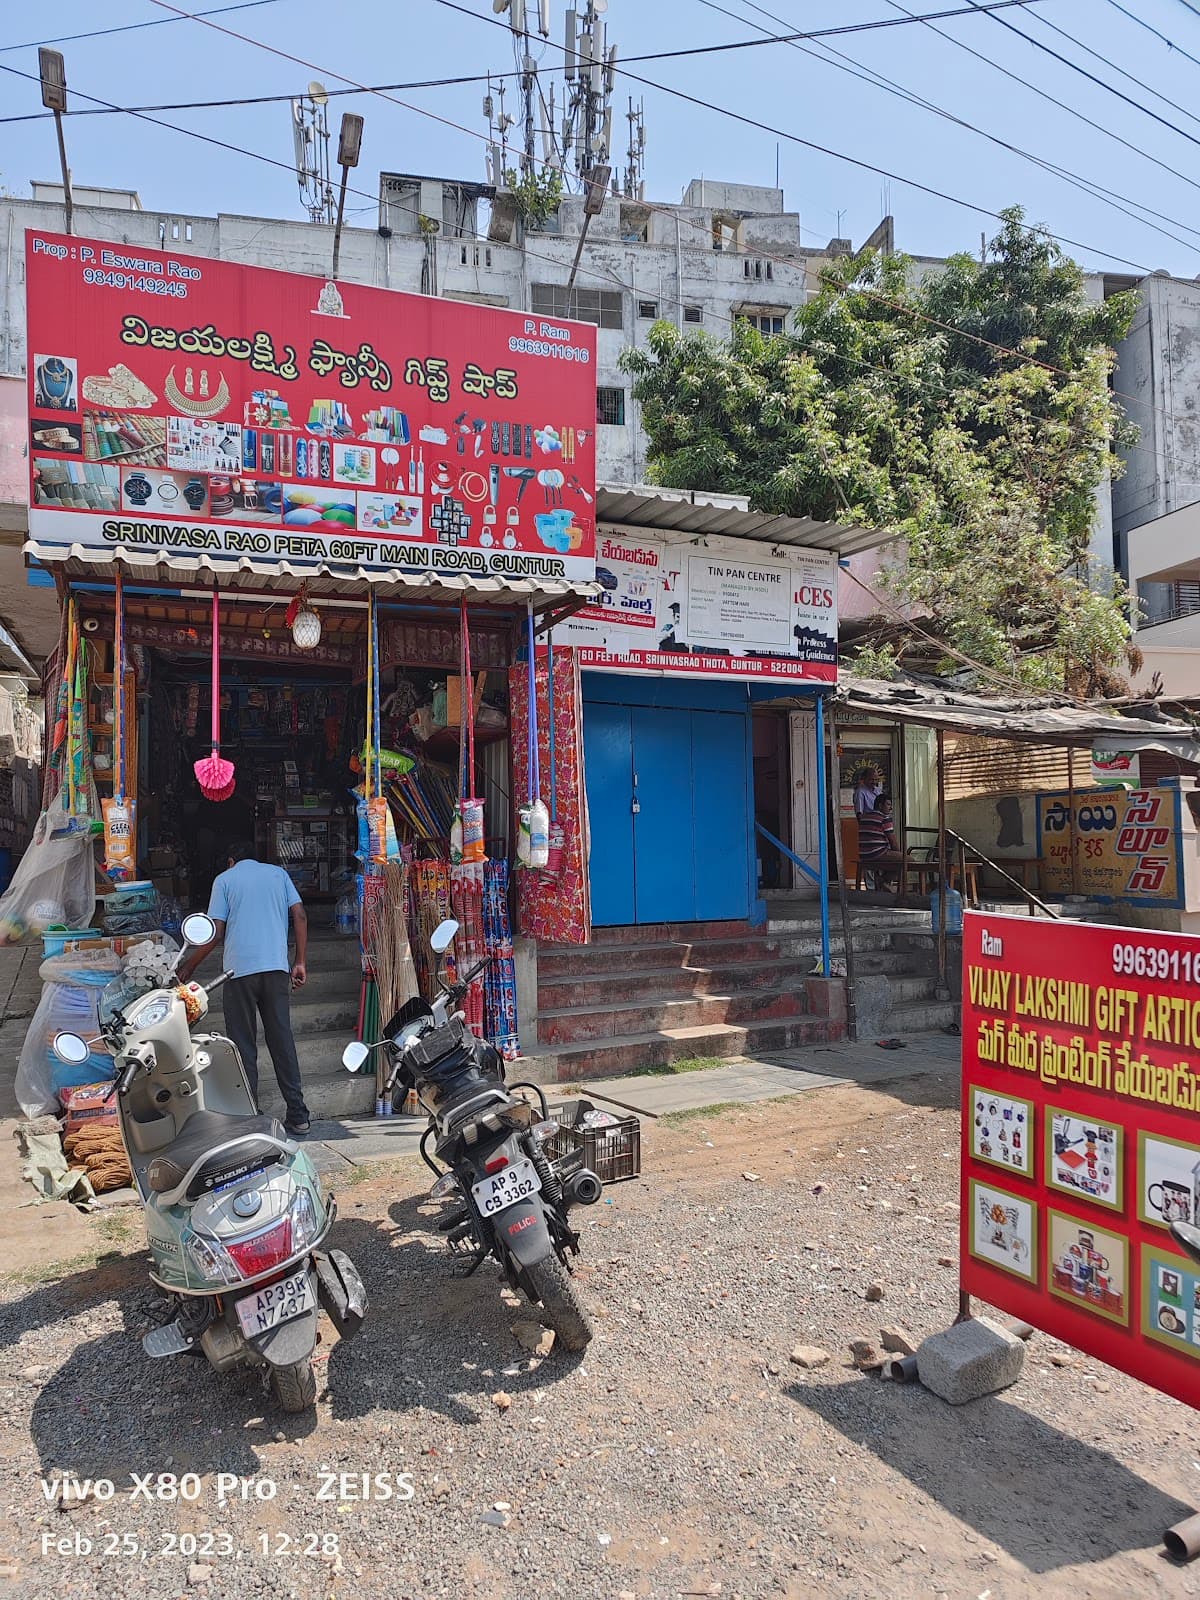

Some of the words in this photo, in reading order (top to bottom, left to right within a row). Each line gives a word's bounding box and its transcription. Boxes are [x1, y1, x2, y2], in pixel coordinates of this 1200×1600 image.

[33, 239, 68, 258] Prop
[80, 247, 97, 264] P.
[102, 250, 163, 274] Eswara
[167, 261, 201, 280] Rao
[83, 268, 188, 298] 9849149245
[524, 320, 537, 336] P.
[540, 322, 570, 341] Ram
[120, 315, 299, 381] విజయలక్ష్మి
[461, 364, 518, 399] షాప్
[509, 337, 589, 362] 9963911616
[103, 521, 221, 549] SRINIVASA
[225, 531, 271, 553] RAO
[274, 535, 328, 557] PETA
[331, 540, 377, 562] 60FT
[380, 543, 428, 566] MAIN
[432, 549, 487, 573] ROAD,
[490, 556, 564, 577] GUNTUR
[708, 566, 724, 577] TIN
[726, 569, 745, 579] PAN
[747, 571, 782, 583] CENTRE
[581, 650, 594, 661] 60
[646, 654, 700, 668] SRINIVASRAO
[702, 657, 729, 670] THOTA,
[731, 659, 762, 672] GUNTUR
[771, 662, 803, 674] 522004
[981, 929, 1003, 957] Ram
[968, 965, 1011, 1011] VIJAY
[1015, 973, 1090, 1027] LAKSHMI
[1095, 985, 1139, 1036] GIFT
[215, 1166, 247, 1183] SUZUKI
[491, 1177, 506, 1194] AP
[509, 1171, 518, 1183] 9
[504, 1179, 534, 1202] 3362
[508, 1215, 537, 1235] POLICE
